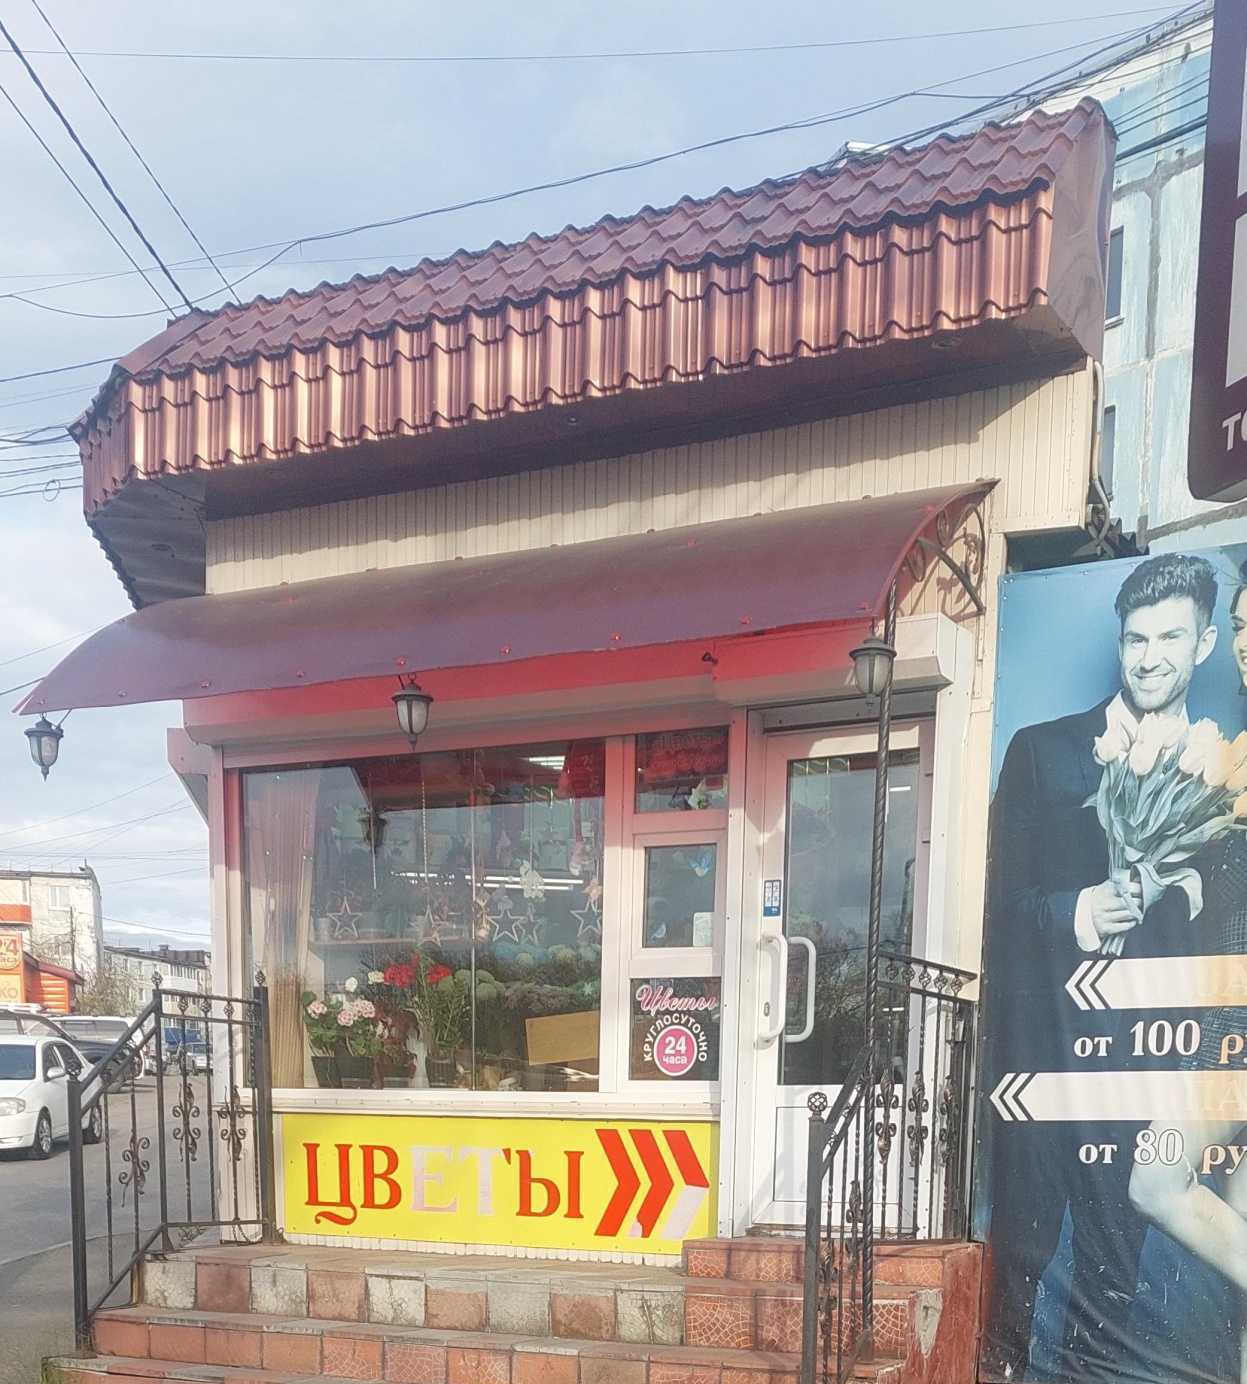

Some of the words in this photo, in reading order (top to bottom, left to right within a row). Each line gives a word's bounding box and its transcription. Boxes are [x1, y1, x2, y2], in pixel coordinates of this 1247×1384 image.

[635, 984, 718, 1017] Цветы
[643, 1013, 708, 1062] КРУГЛОСУТОЧНО
[664, 1035, 687, 1055] 24
[1073, 1036, 1113, 1057] от
[1129, 1019, 1200, 1057] 100
[1217, 1033, 1247, 1065] р
[662, 1055, 688, 1065] часа
[1078, 1143, 1118, 1165] от
[1133, 1128, 1185, 1166] 80
[302, 1142, 585, 1225] ЦВЕТЫ
